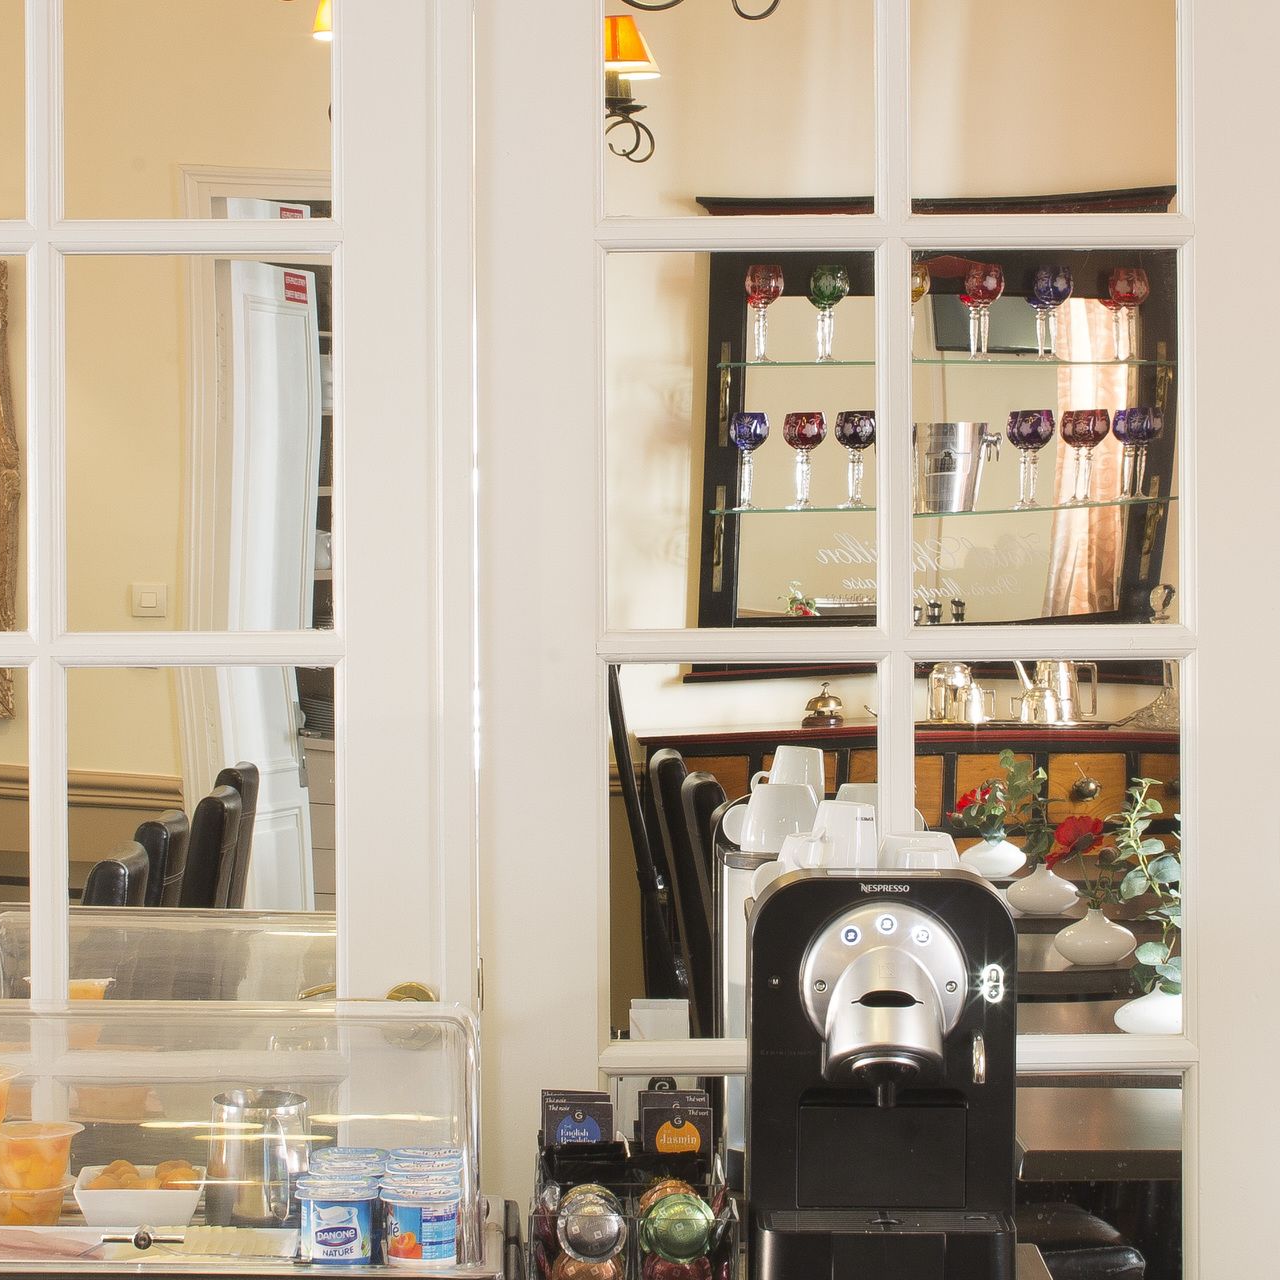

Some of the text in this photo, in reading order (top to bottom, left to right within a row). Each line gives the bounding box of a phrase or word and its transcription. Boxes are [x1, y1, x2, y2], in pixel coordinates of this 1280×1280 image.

[859, 883, 910, 893] NESPRESSO
[316, 1229, 356, 1241] DANONE
[322, 1246, 354, 1257] NATURE
